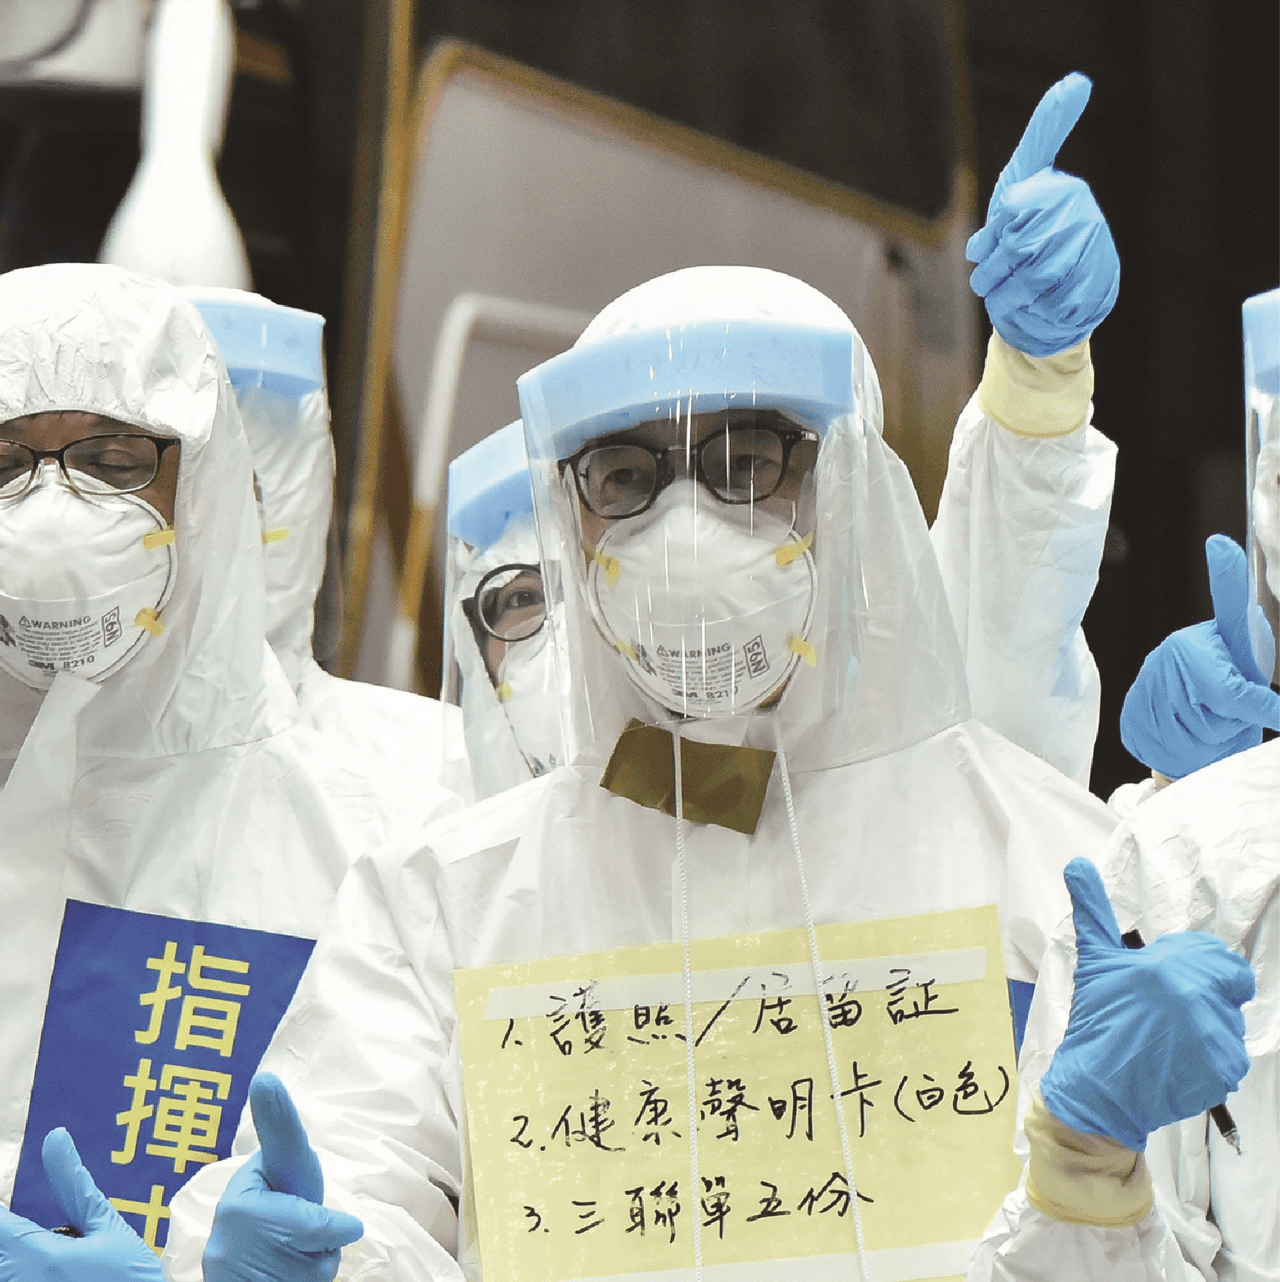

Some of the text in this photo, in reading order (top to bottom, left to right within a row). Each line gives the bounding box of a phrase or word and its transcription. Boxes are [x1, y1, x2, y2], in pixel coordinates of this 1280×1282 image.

[31, 615, 92, 630] WARNING
[105, 612, 120, 641] N95
[63, 654, 96, 668] 8210
[747, 640, 767, 674] N95
